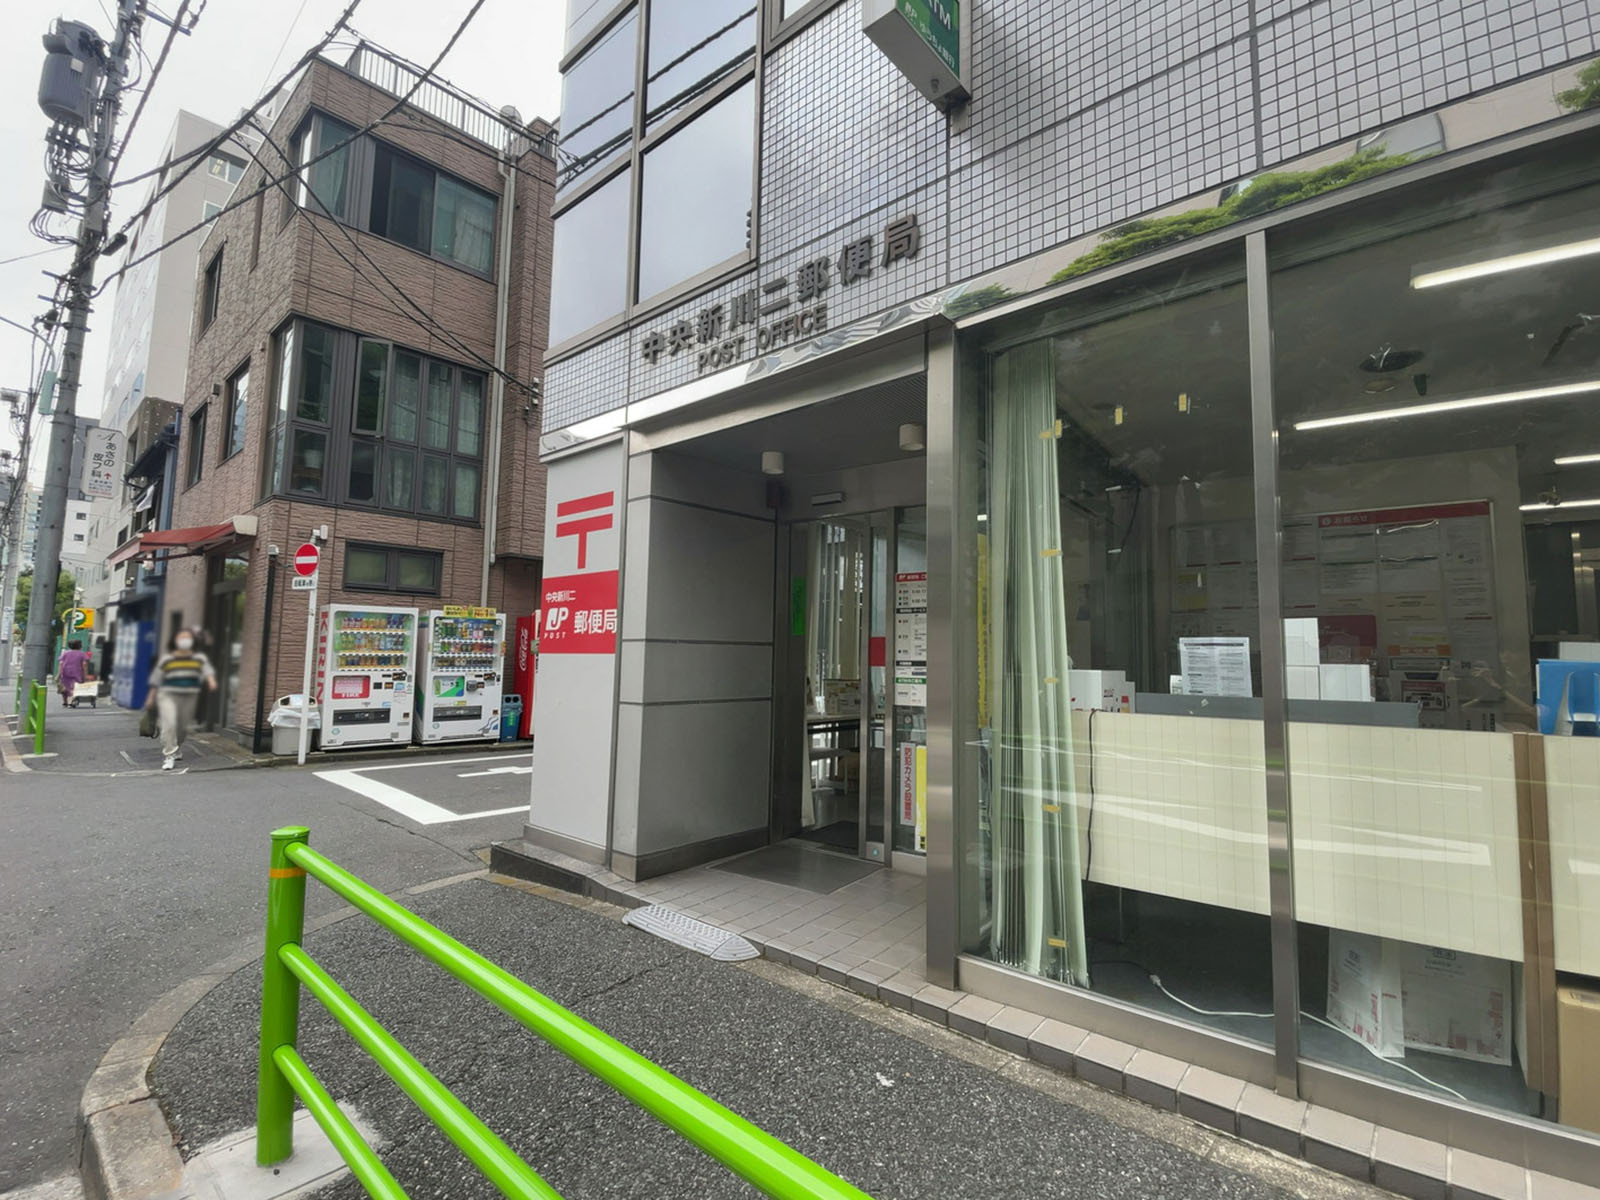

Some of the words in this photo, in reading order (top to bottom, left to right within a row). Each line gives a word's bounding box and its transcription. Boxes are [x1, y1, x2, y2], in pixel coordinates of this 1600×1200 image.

[642, 213, 921, 364] 中央新川二郵便局
[697, 335, 745, 373] POST
[756, 303, 828, 350] OFFICE
[545, 589, 576, 603] 中央新川二
[544, 631, 567, 639] POST
[574, 608, 618, 635] 郵便局
